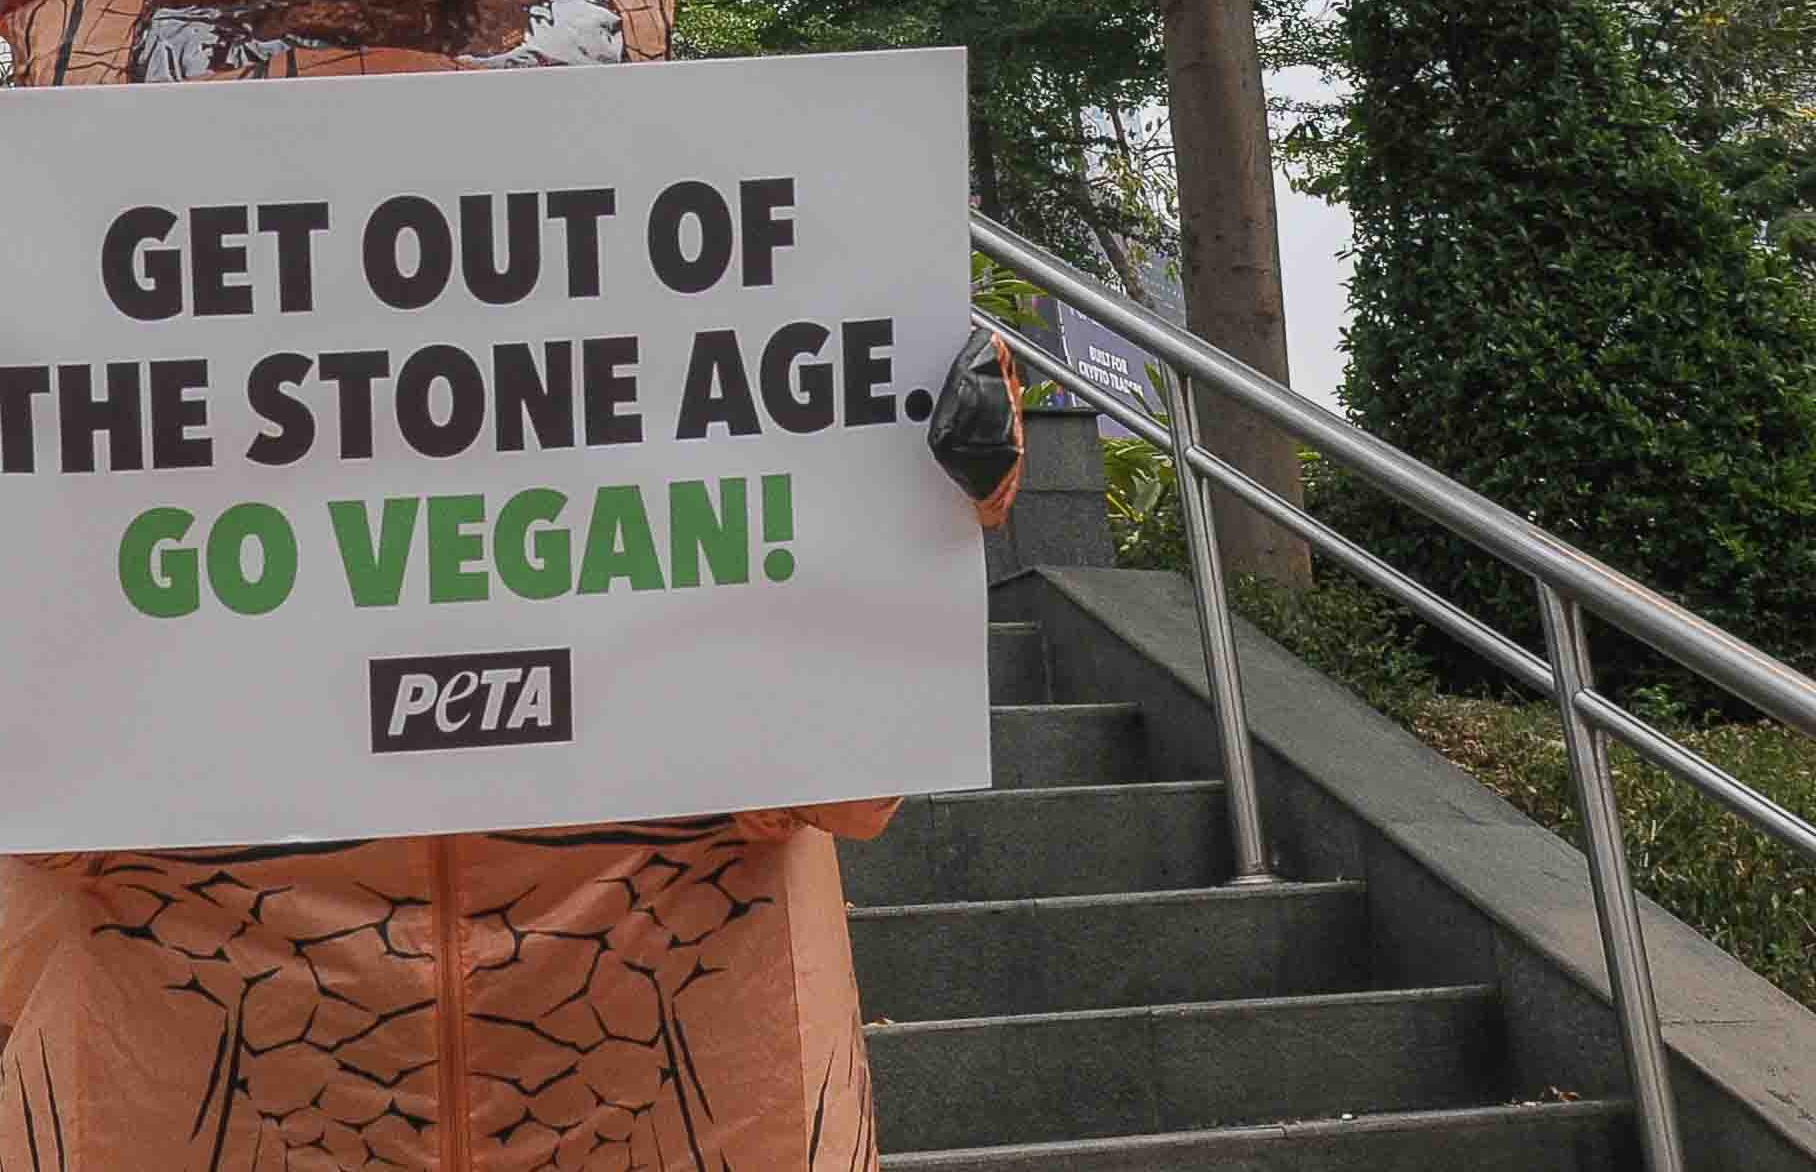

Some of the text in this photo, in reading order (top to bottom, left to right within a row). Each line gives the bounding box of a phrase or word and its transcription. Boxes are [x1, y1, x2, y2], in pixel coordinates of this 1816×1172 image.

[101, 177, 797, 322] GET OUT OF
[244, 336, 644, 466] STONE
[675, 317, 934, 440] AGE.
[118, 473, 797, 620] GO VEGAN!
[387, 664, 556, 739] PeTA
